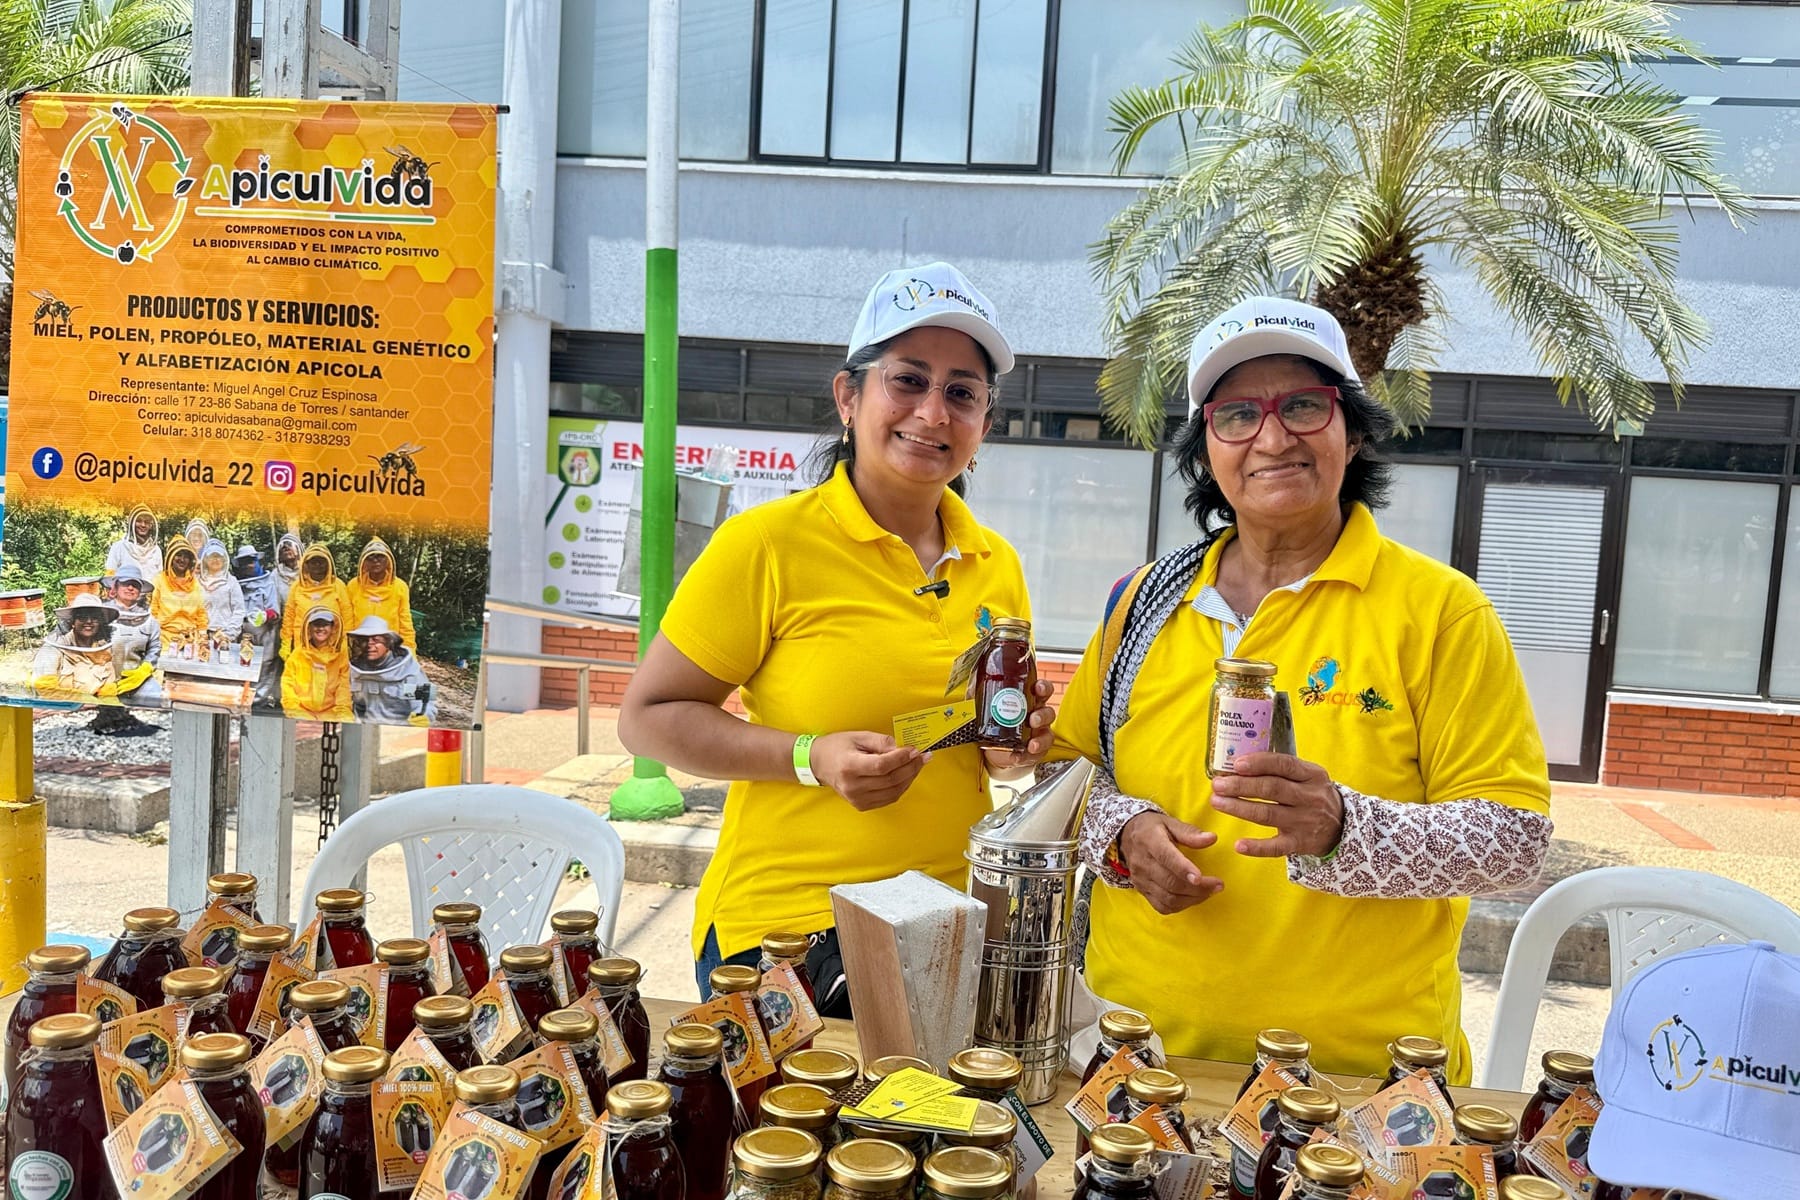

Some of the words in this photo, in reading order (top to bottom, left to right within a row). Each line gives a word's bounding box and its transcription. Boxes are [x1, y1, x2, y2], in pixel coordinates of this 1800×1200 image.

[225, 225, 325, 238] COMPROMETIDOS
[329, 228, 355, 239] CON
[358, 230, 374, 240] LA
[376, 231, 406, 243] VIDA,
[193, 238, 207, 248] LA
[210, 239, 296, 251] BIODIVERSIDAD
[301, 242, 309, 252] Y
[312, 243, 326, 253] EL
[330, 245, 382, 255] IMPACTO
[385, 247, 439, 257] POSITIVO
[246, 255, 261, 264] AL
[263, 256, 310, 267] CAMBIO
[314, 257, 382, 271] CLIMÁTICO.
[127, 295, 242, 321] PRODUCTOS
[247, 299, 259, 322] Y
[263, 300, 380, 328] SERVICIOS:
[34, 323, 83, 341] MIEL,
[89, 326, 155, 345] POLEN,
[160, 329, 261, 350] PROPÓLEO,
[268, 334, 366, 353] MATERIAL
[372, 340, 471, 358] GENÉTICO
[118, 352, 130, 367] Y
[135, 353, 290, 373] ALFABETIZACIÓN
[296, 361, 383, 379] APICOLA
[120, 377, 209, 392] Representante:
[213, 382, 250, 396] Miguel
[252, 384, 285, 399] Angel
[289, 386, 317, 398] Cruz
[322, 388, 378, 405] Espinosa
[88, 390, 151, 404] Dirección:
[154, 395, 180, 406] calle
[183, 396, 196, 407] 17
[199, 396, 231, 409] 23-86
[234, 399, 278, 412] Sabana
[281, 401, 297, 413] de
[300, 402, 339, 414] Torres
[341, 404, 347, 415] /
[349, 406, 409, 419] santander
[137, 408, 181, 422] Correo:
[184, 411, 357, 431] apiculvidasabana@gmail.com
[143, 423, 188, 437] Celular:
[191, 426, 212, 438] 318
[215, 427, 264, 441] 8074362
[275, 431, 351, 447] 3187938293
[613, 442, 796, 471] ENERERÍA
[74, 452, 254, 489] @apiculvida_22
[301, 467, 426, 497] apiculvida
[743, 471, 794, 481] AUXILIOS
[1021, 1111, 1031, 1123] EL
[1027, 1121, 1044, 1144] APOYO
[1373, 1165, 1401, 1186] PURA!
[1482, 1157, 1495, 1183] ¡MIEL
